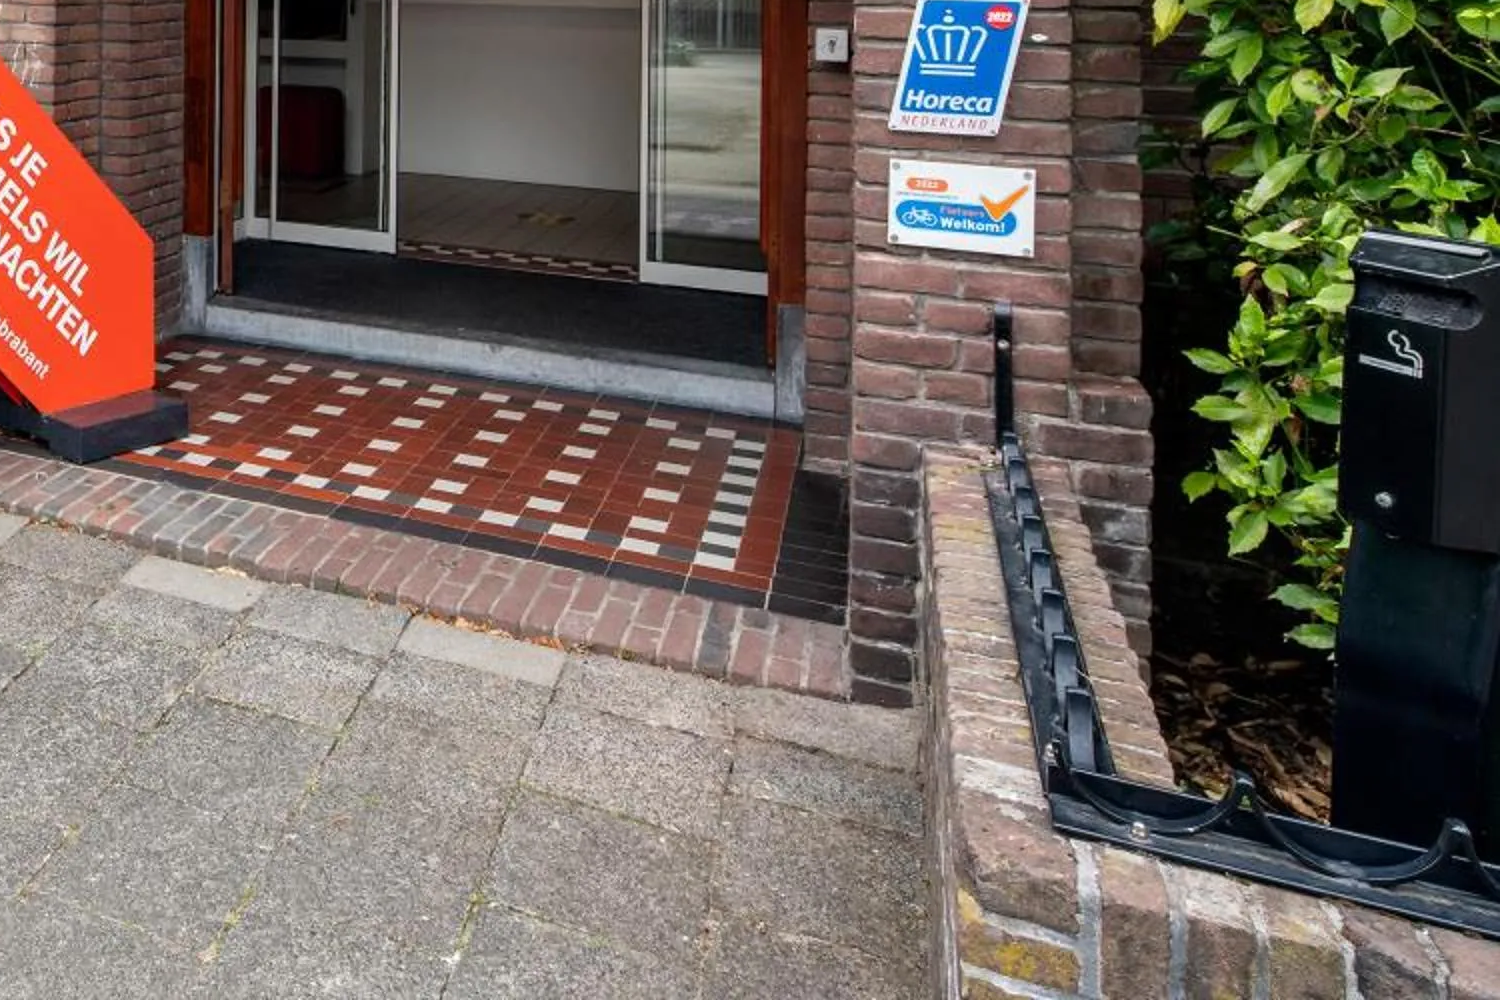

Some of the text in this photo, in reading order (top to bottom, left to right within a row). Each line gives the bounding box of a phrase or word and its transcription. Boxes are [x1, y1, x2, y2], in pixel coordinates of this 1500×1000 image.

[905, 89, 993, 113] Horeca
[901, 115, 989, 130] NEDERLAND
[8, 140, 49, 188] JE
[941, 217, 1005, 233] Welkom!
[41, 226, 90, 297] WIL
